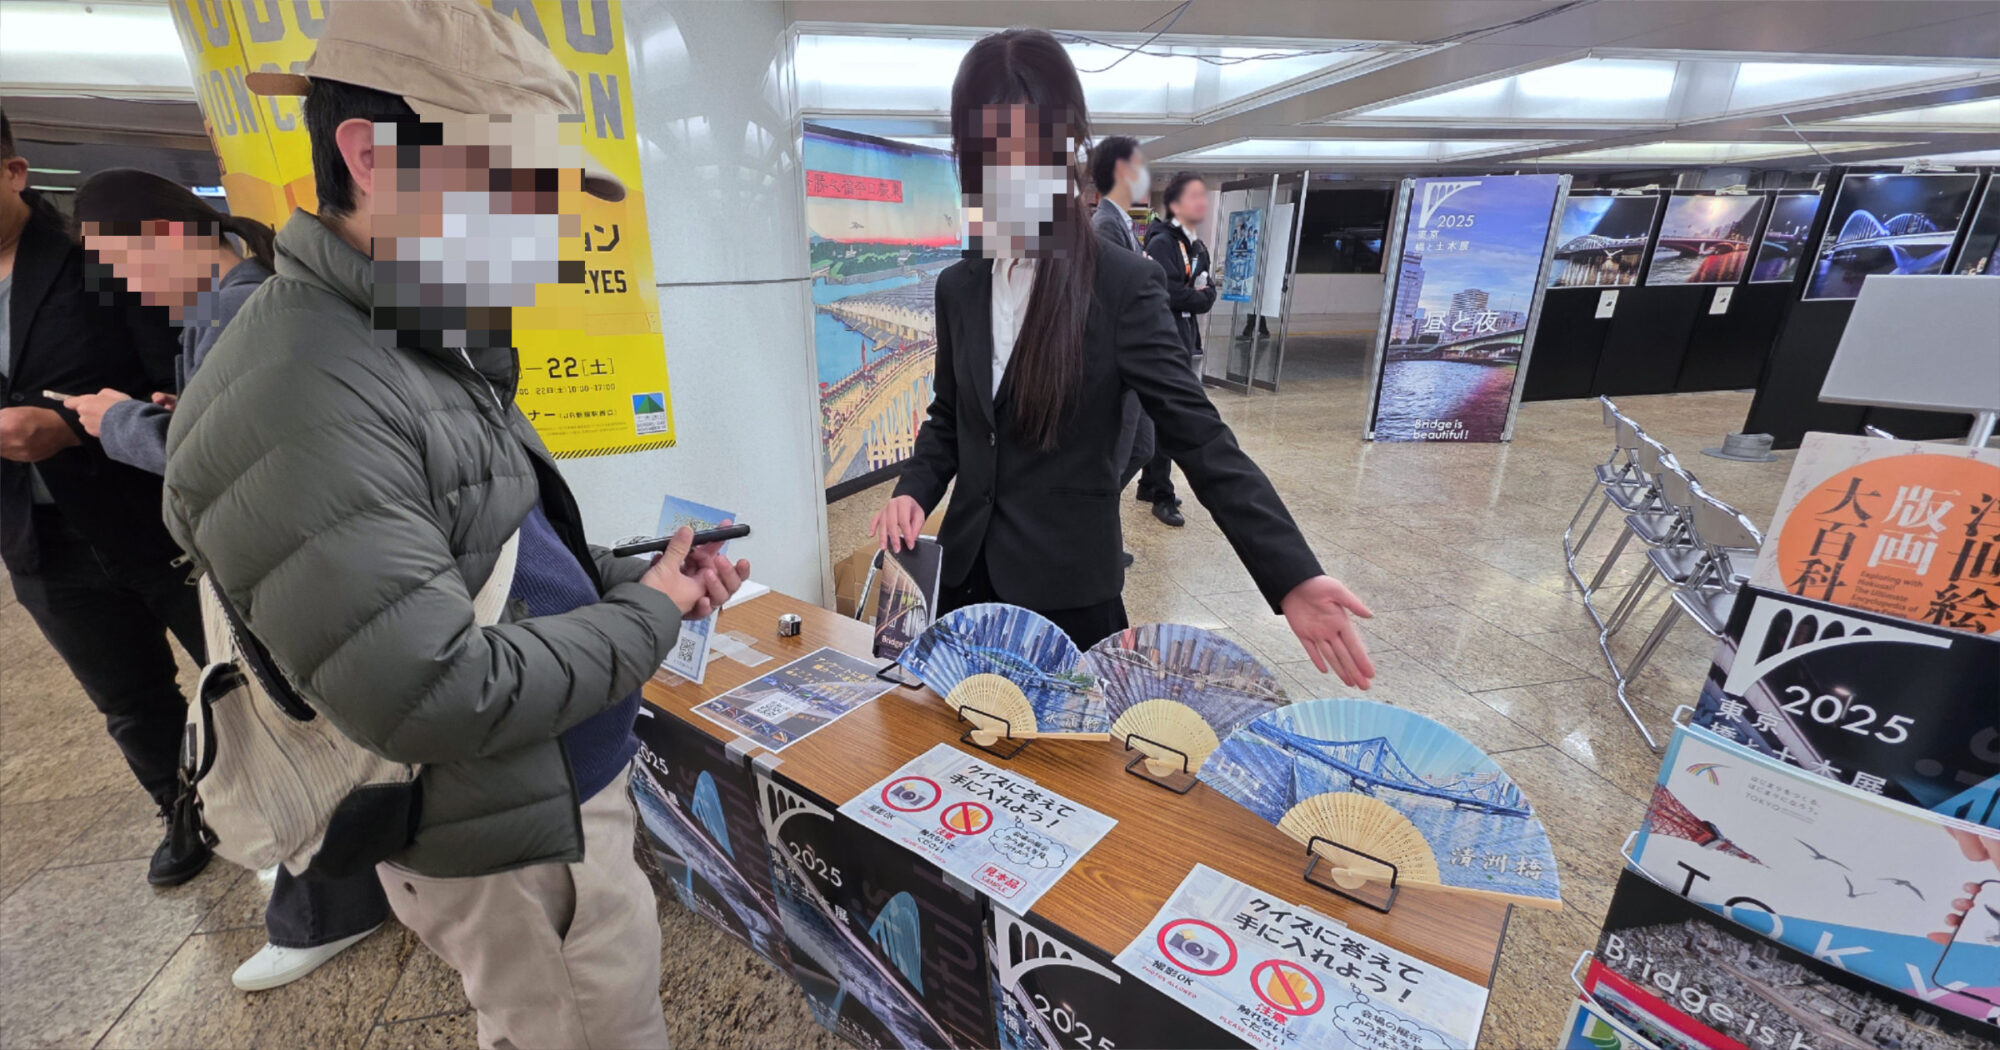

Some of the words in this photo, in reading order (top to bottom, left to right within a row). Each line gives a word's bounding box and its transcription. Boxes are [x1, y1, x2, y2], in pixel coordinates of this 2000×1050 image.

[1418, 230, 1440, 239] 東京
[1437, 215, 1475, 228] 2025
[1423, 310, 1500, 333] 昼と夜
[1414, 420, 1453, 431] Bridge
[1454, 420, 1464, 429] is
[1789, 477, 1882, 601] 大百科
[1867, 485, 1961, 576] 版画
[1715, 698, 1784, 735] 東京
[1780, 685, 1915, 744] 2025
[967, 764, 1076, 818] クイズに答えて
[789, 842, 843, 887] 2025
[984, 866, 1020, 889] 見本品
[1249, 898, 1424, 985] クイズに答えて
[1604, 934, 1734, 1024] Bridge
[1745, 1011, 1778, 1046] is
[1237, 1004, 1297, 1041] 触れないで
[1240, 1017, 1285, 1046] ください
[1255, 1003, 1288, 1026] 注意
